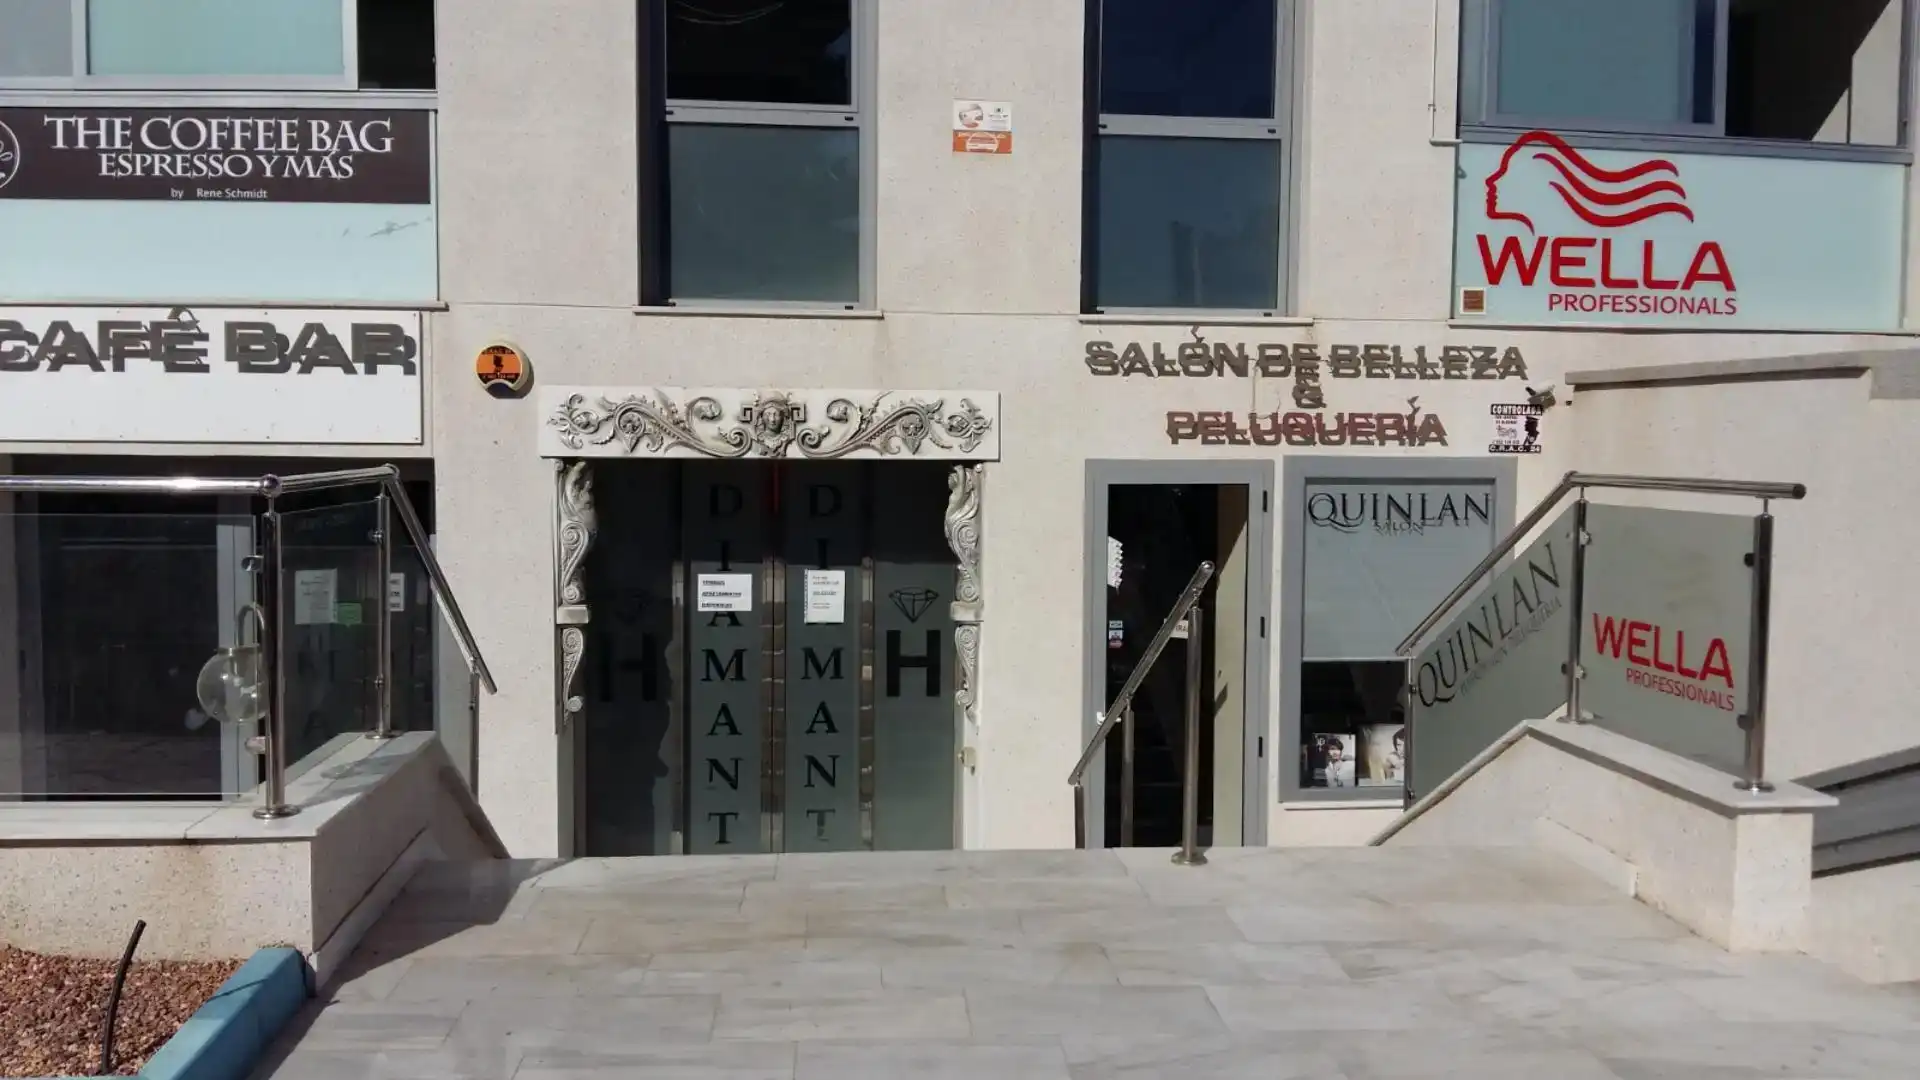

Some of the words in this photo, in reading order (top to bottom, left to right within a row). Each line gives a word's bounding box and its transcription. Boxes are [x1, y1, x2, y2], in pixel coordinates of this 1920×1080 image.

[44, 115, 133, 152] THE
[140, 115, 300, 153] COFFEE
[307, 117, 395, 153] BAG
[98, 152, 252, 178] ESPRESSO
[256, 154, 280, 178] Y
[282, 150, 354, 180] MÁS
[170, 188, 184, 198] by
[197, 188, 222, 197] Rene
[225, 188, 268, 198] Schmidt
[1476, 234, 1736, 291] WELLA
[1548, 294, 1737, 315] PROFESSIONALS
[225, 321, 416, 375] BAR
[1085, 326, 1248, 377] SALÓN
[1257, 343, 1320, 378] DE
[1329, 344, 1528, 380] BELLEZA
[1166, 396, 1448, 446] PELUQUERÍA
[1308, 493, 1490, 530] QUINLAN
[1418, 541, 1560, 707] QUINLAN
[801, 484, 844, 841] DIMANT
[886, 630, 941, 697] H
[1592, 613, 1734, 689] WELLA
[1627, 668, 1735, 711] PROFESSIONALS
